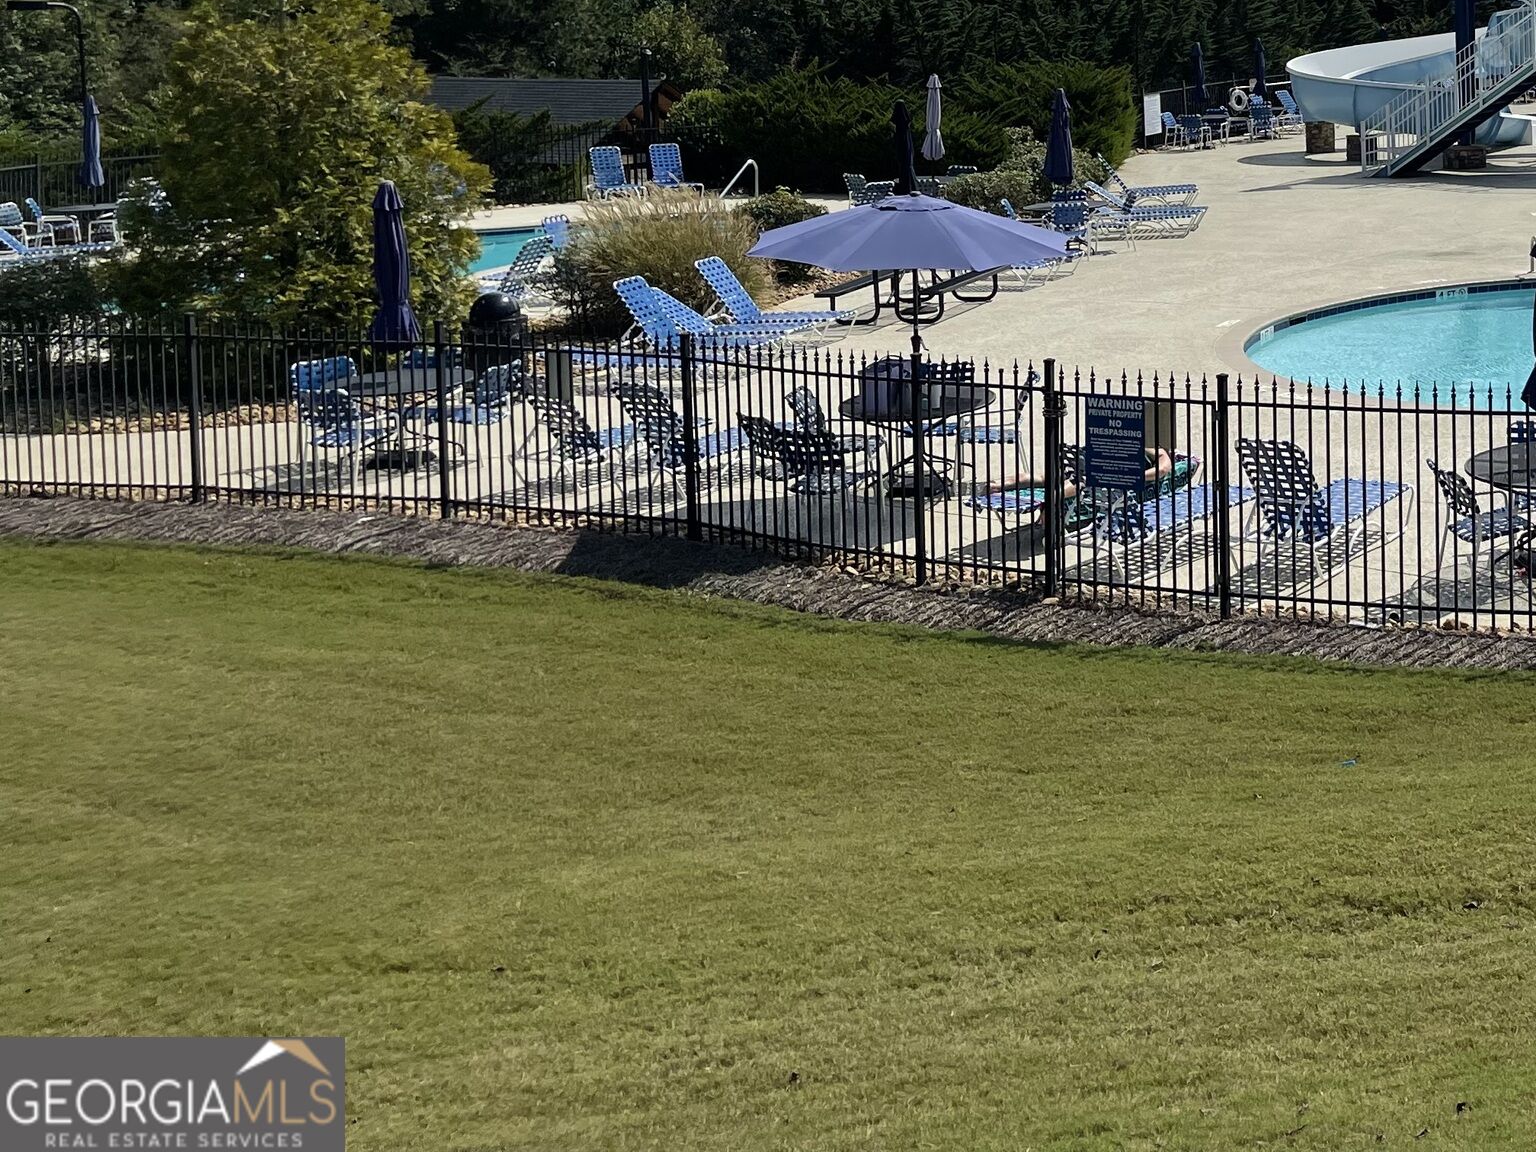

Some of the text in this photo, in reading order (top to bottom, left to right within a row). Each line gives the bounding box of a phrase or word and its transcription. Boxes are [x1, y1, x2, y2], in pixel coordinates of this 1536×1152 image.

[1087, 397, 1143, 410] WARNING
[1088, 408, 1142, 419] PRIVATE PROPERTY
[1108, 419, 1122, 428] NO
[1088, 427, 1142, 438] TRESPASSING
